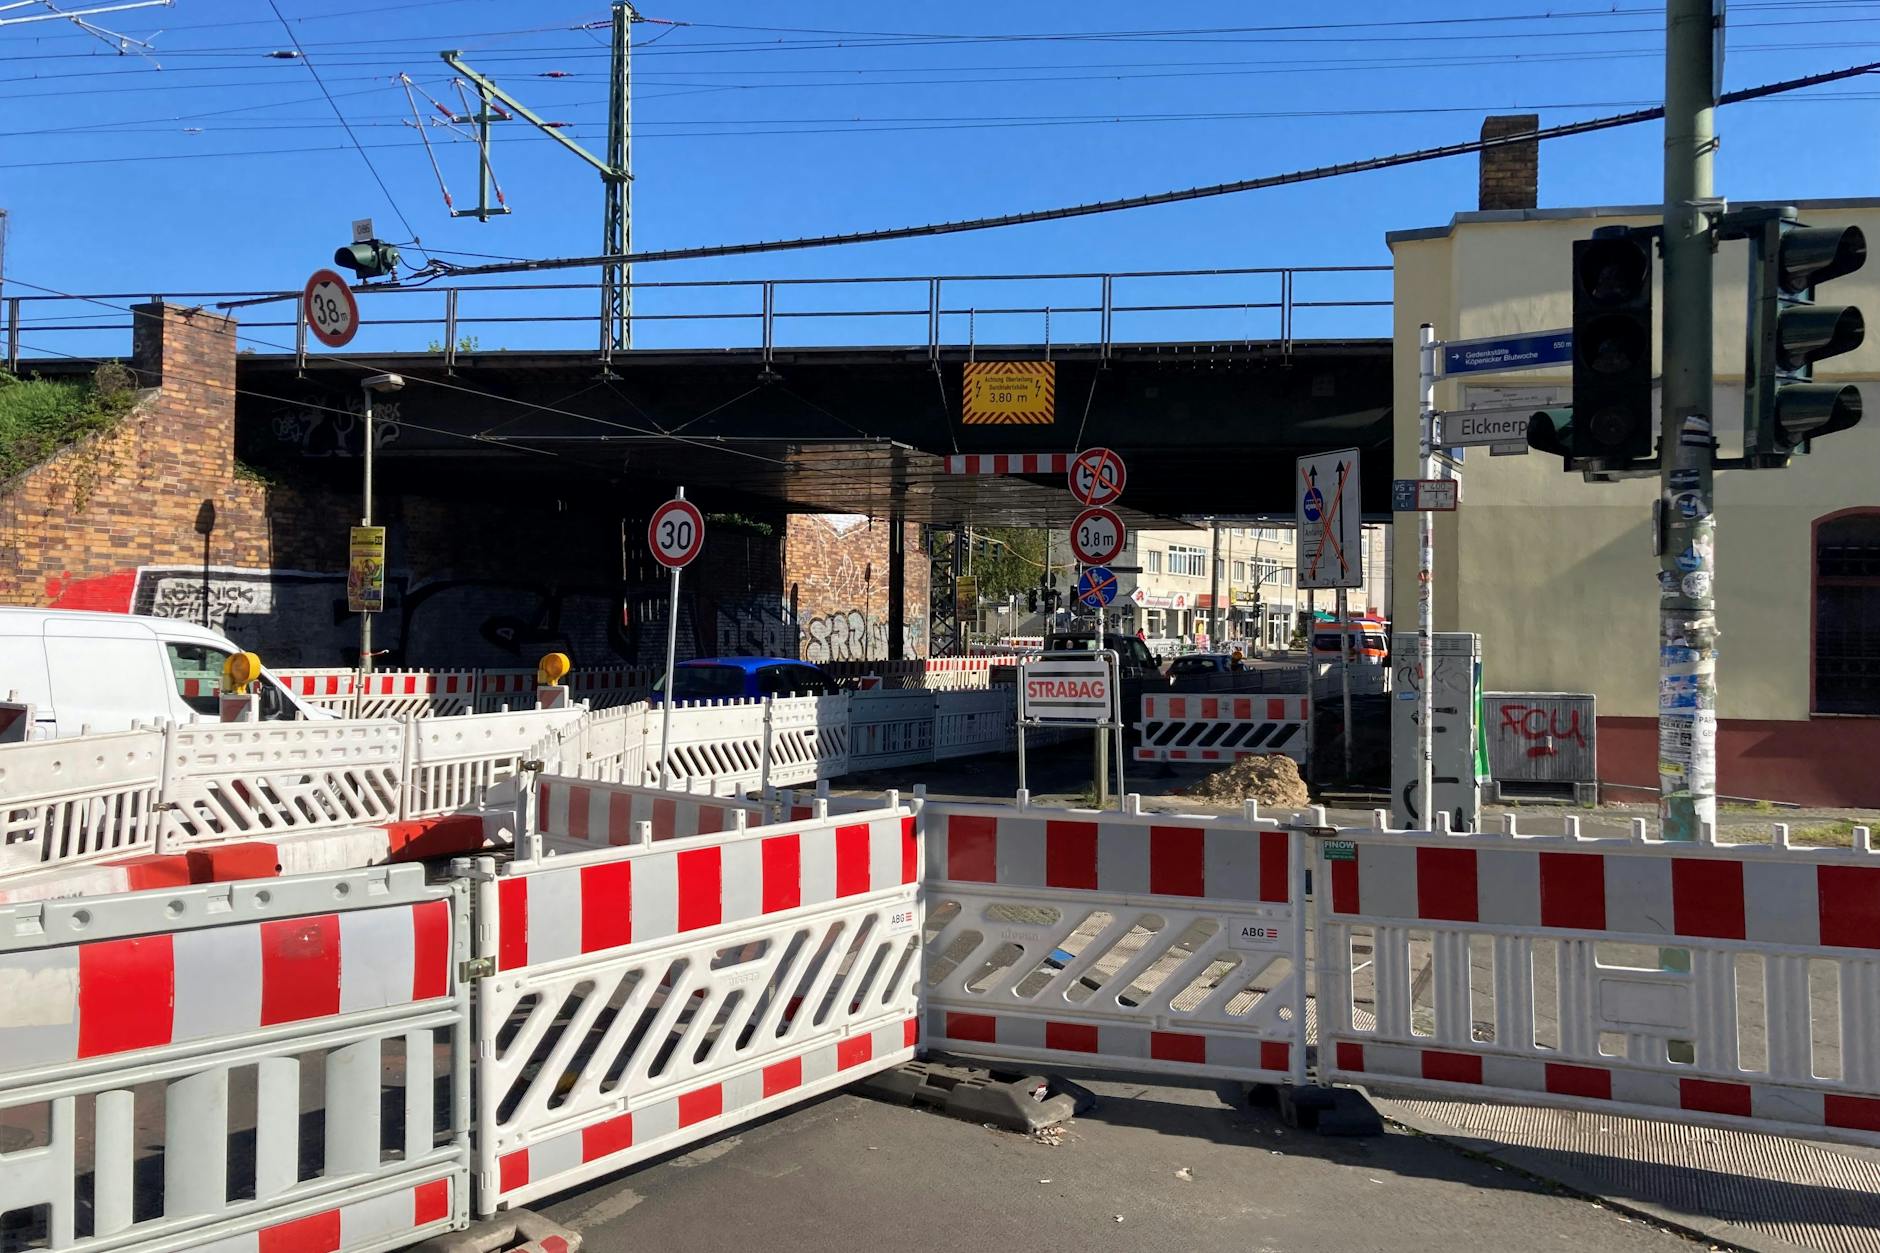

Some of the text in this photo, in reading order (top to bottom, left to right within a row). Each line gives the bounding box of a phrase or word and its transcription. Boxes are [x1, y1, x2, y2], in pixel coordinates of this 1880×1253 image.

[341, 312, 349, 322] m
[1503, 352, 1539, 361] Blutwoche
[1017, 394, 1028, 403] m
[1461, 416, 1532, 436] Elcknerp
[1083, 464, 1113, 489] 50
[661, 520, 692, 550] 30
[1103, 535, 1114, 546] m
[1028, 681, 1105, 698] STRABAG
[1324, 841, 1355, 849] FINOW
[891, 914, 904, 924] ABG
[1241, 927, 1264, 937] ABG
